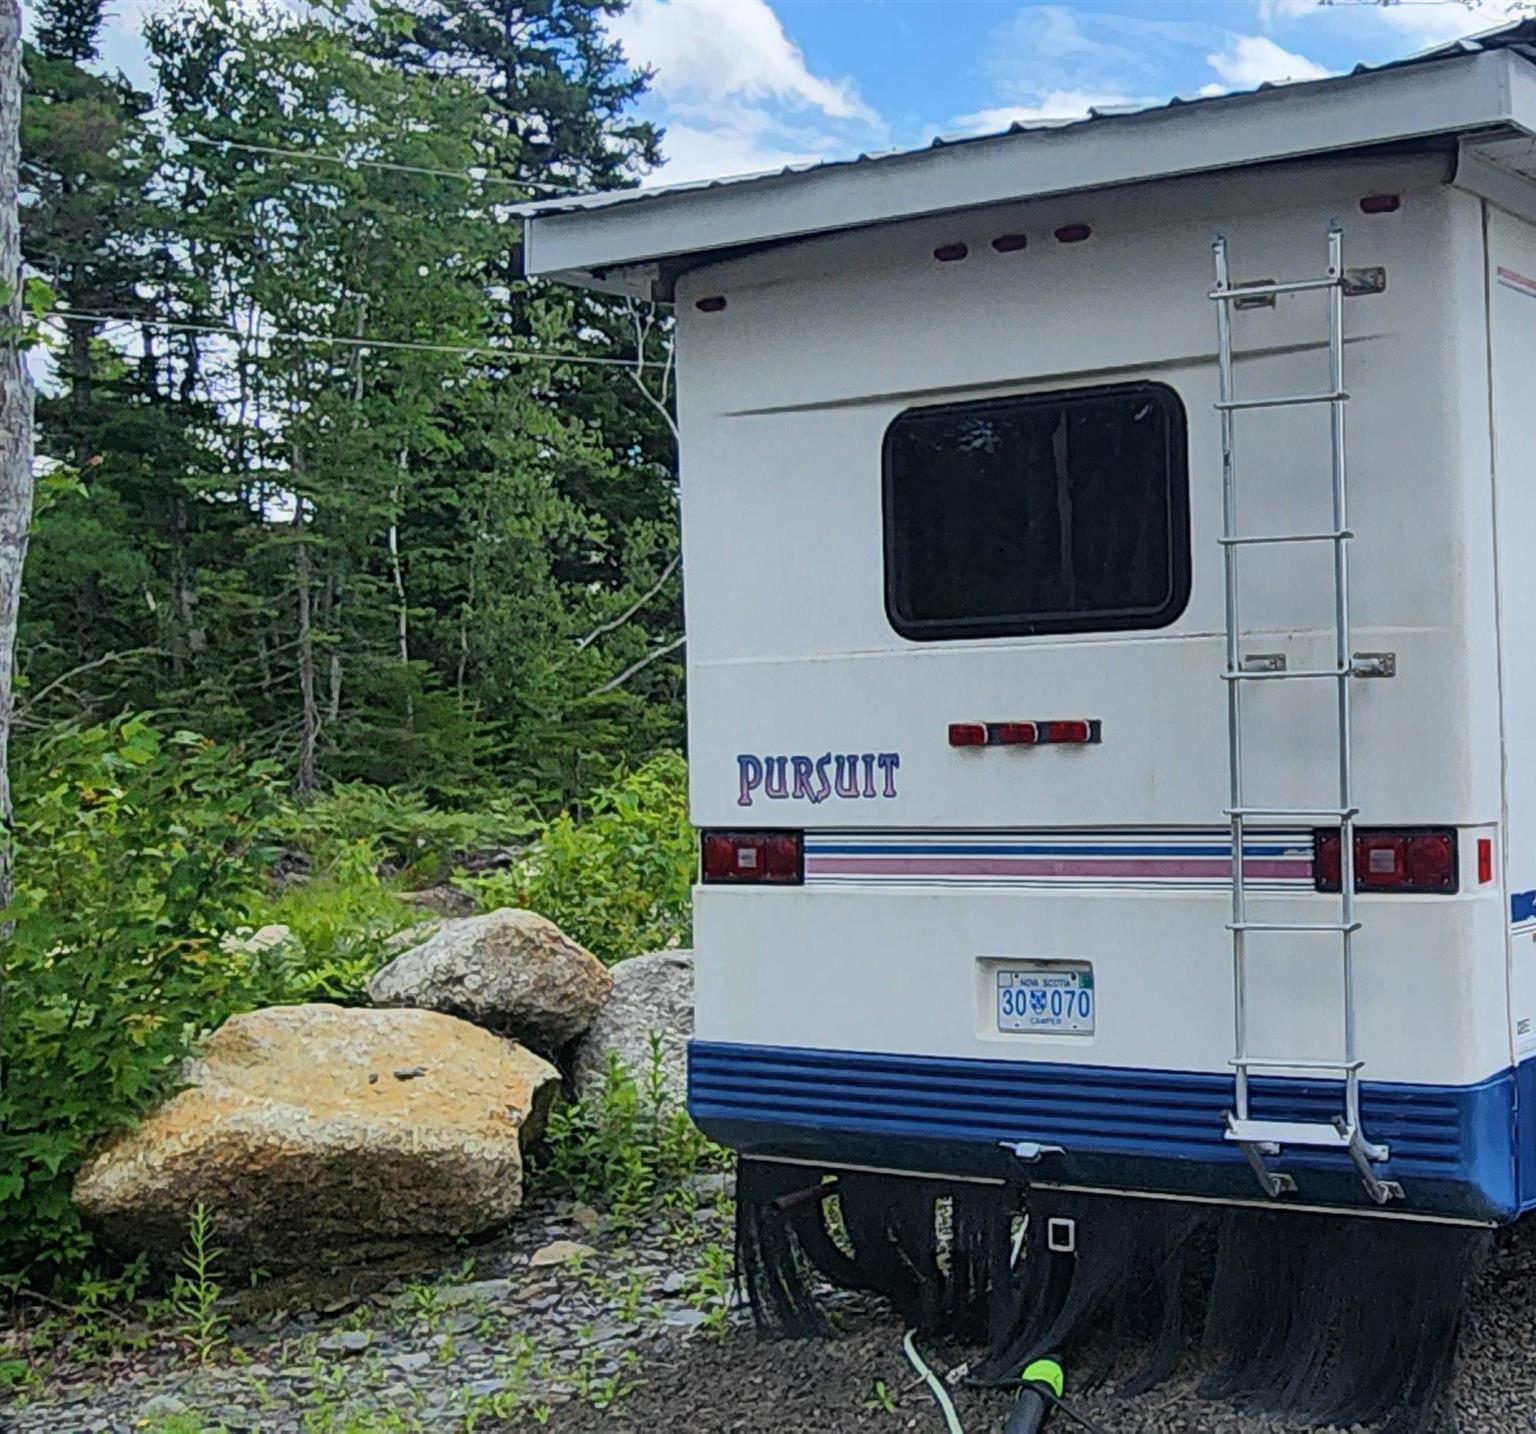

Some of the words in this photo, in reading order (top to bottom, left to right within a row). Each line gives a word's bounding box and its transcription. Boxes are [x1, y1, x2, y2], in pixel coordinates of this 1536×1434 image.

[736, 751, 900, 807] PURSUIT
[1002, 988, 1027, 1017] 30
[1050, 988, 1091, 1018] 070
